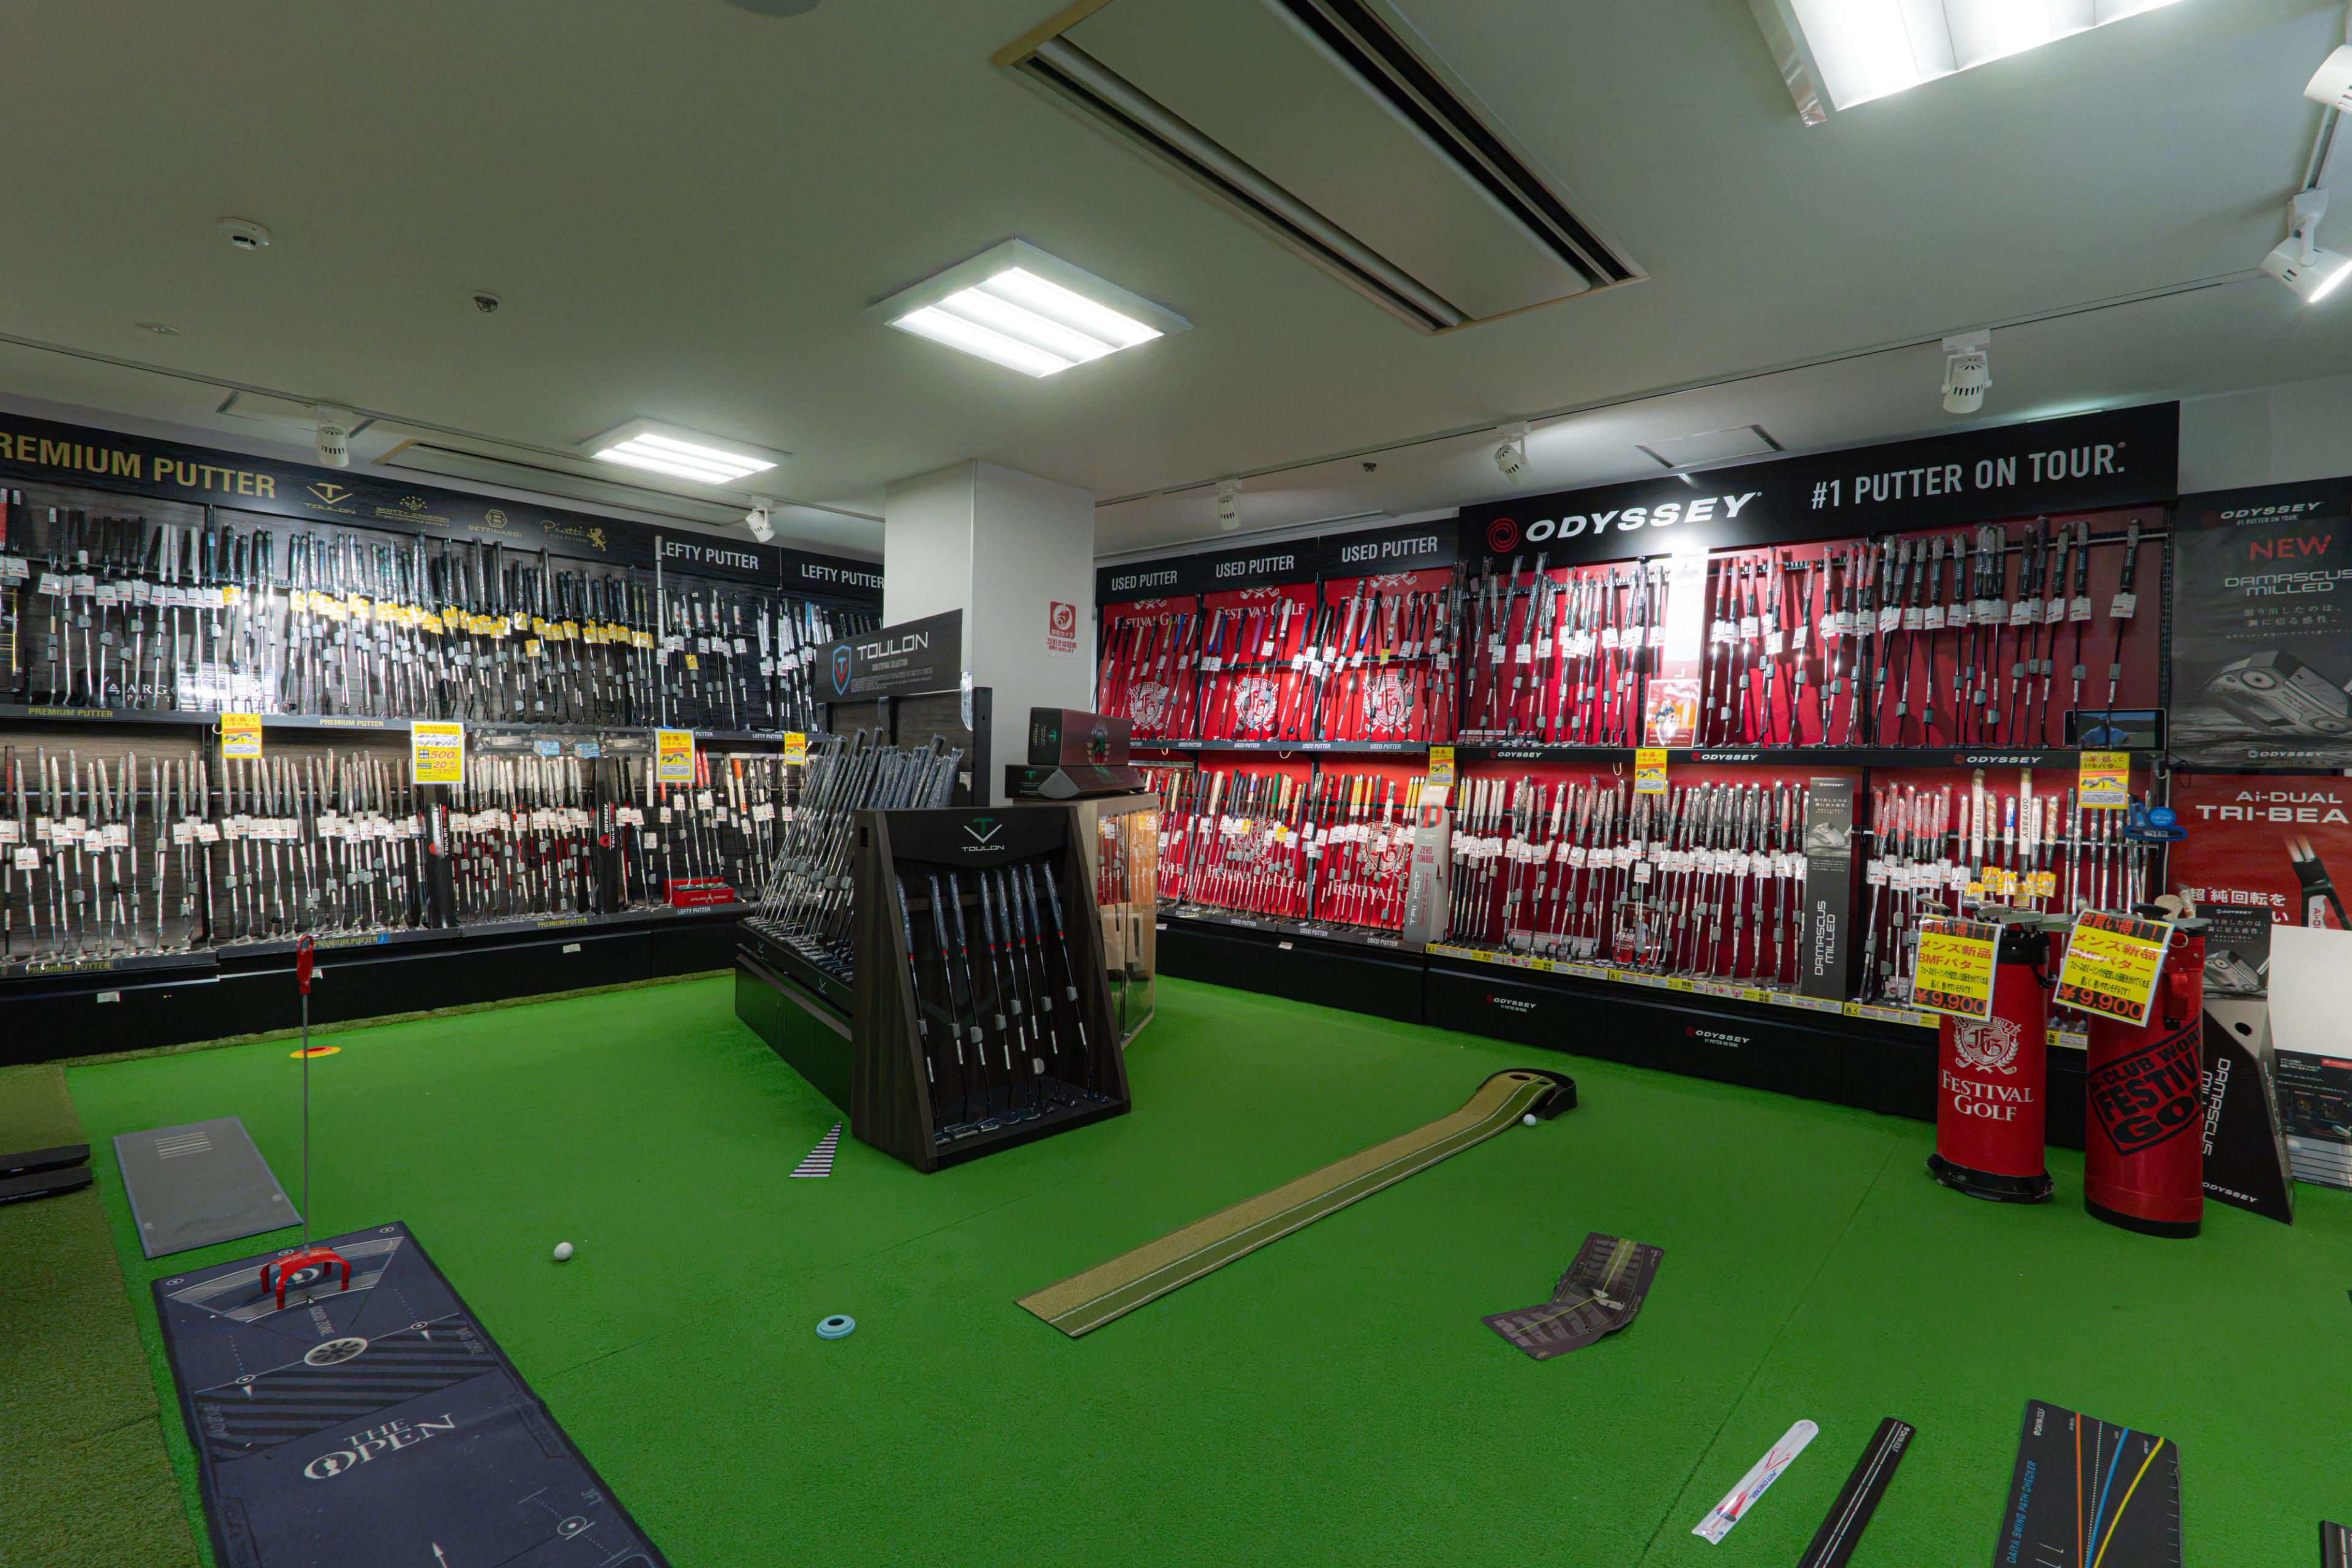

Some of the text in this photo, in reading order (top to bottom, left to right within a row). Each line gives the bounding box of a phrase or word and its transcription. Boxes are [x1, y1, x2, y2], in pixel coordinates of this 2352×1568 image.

[154, 456, 275, 499] PUTTER
[1811, 480, 1841, 510] #1
[1855, 464, 1962, 504] PUTTER
[1975, 456, 2017, 489] ON
[304, 502, 356, 514] TOULON
[376, 507, 408, 515] SCOTTY
[412, 512, 450, 522] CAMERON
[1525, 492, 1757, 542] ODYSSEY
[2220, 502, 2322, 519] ODYSSEY
[468, 524, 522, 538] BETTINARDI
[662, 541, 759, 570] EFTY PUTTER
[1341, 535, 1438, 563] USED PUTTER
[2249, 534, 2332, 561] NEW
[802, 563, 884, 589] LEFTY PUTTER
[1216, 554, 1295, 579] USED PUTTER
[1111, 570, 1178, 592] USED PUTTER
[2225, 568, 2352, 587] DAMASCUS
[2247, 581, 2334, 597] MILLED
[1051, 628, 1074, 638] 防犯カメラ
[857, 631, 929, 661] TOULON
[1047, 638, 1077, 649] 万引きは犯罪
[28, 707, 113, 718] PREMIUM PUTTER
[319, 718, 355, 726] PREMIUM
[1967, 755, 2042, 764] ODYSSEY
[2236, 791, 2343, 804] Ai-DUAL
[961, 844, 1005, 853] TOULON
[1419, 845, 1433, 854] ZERO
[1416, 854, 1435, 864] TORQUE
[314, 936, 378, 947] PREMIUM PUTTER
[1312, 929, 1329, 937] PUTTER
[1814, 900, 1826, 976] DAMASCUS
[1825, 914, 1836, 964] MILLED
[1919, 940, 1992, 960] メンズ新品
[2073, 933, 2158, 962] メンズ新品
[26, 961, 111, 974] PREMIUM PUTTER
[1918, 952, 1988, 970] BMFパター
[1493, 997, 1538, 1009] ODYSSEY
[1992, 1018, 2009, 1028] GOLF
[1695, 1029, 1751, 1044] ODYSSEY
[1942, 1069, 2034, 1103] FESTIVAL
[1954, 1095, 2017, 1121] GOLF
[2203, 1058, 2231, 1156] DAMASCUS
[2203, 1182, 2260, 1203] ODYSSEY
[308, 1305, 335, 1337] GOOD ZONE
[342, 1417, 409, 1447] THE
[304, 1413, 456, 1480] OPEN
[1748, 1468, 1777, 1500] PUTT CHECKER
[2006, 1493, 2029, 1565] DAIYA SWING PATH
